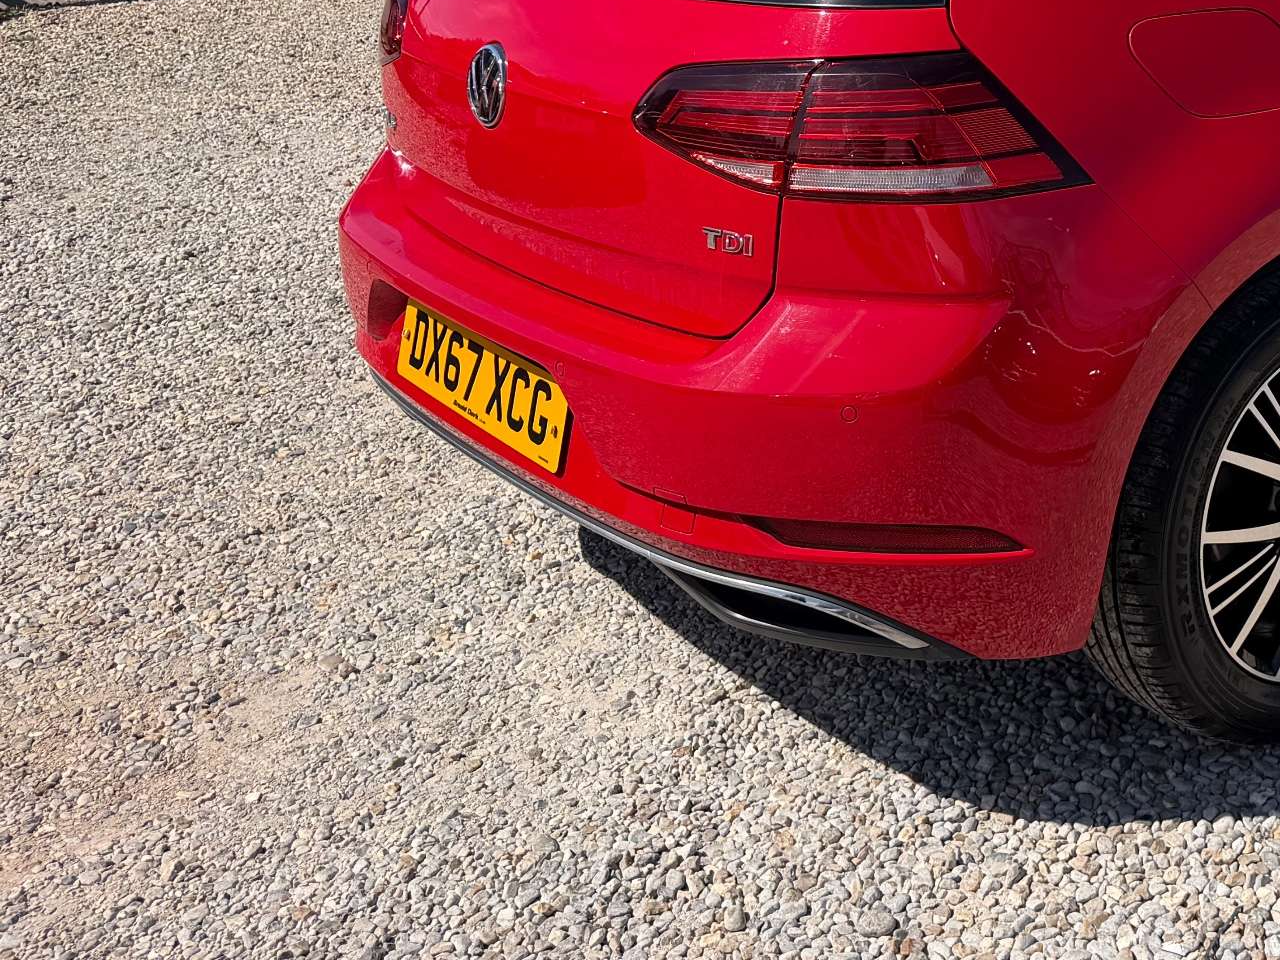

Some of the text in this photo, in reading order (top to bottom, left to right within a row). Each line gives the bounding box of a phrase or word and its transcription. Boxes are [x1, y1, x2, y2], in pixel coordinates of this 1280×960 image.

[702, 226, 753, 257] TDI
[409, 308, 552, 446] DX67 XCG
